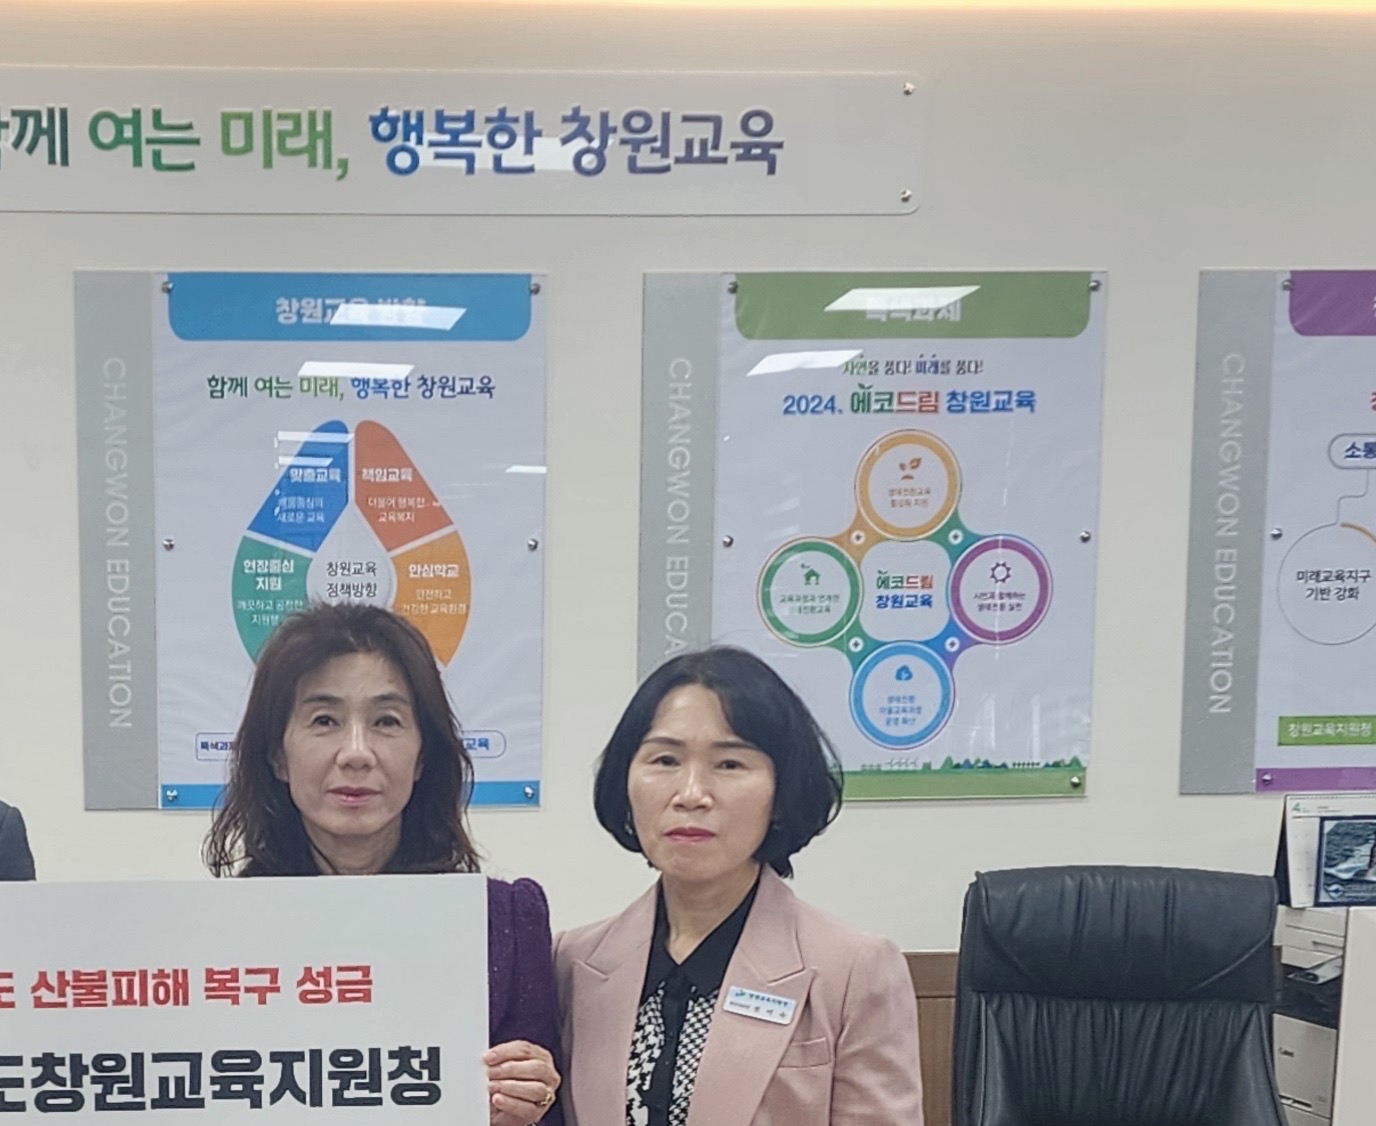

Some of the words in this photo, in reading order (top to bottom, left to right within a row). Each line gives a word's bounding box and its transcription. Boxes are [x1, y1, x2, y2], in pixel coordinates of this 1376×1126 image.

[88, 106, 202, 172] 여는
[220, 107, 349, 181] 미래,
[369, 105, 543, 176] 행복한
[559, 105, 784, 176] 창원교육
[276, 296, 370, 324] 창원교
[207, 375, 248, 399] 함께
[254, 376, 292, 399] 여는
[300, 375, 344, 401] 미래,
[351, 375, 410, 399] 행복한
[417, 375, 496, 399] 창원교육
[783, 395, 843, 414] 2024.
[850, 386, 940, 414] 에코드림
[946, 390, 1036, 414] 창원교육
[102, 357, 129, 547] CHANGWON
[667, 357, 692, 544] CHANGWON
[1215, 353, 1245, 537] CHANGWON
[326, 561, 376, 576] 창원교육
[876, 571, 934, 590] 에코드림
[1296, 569, 1372, 584] 미래교육지구
[326, 582, 377, 598] 정책방향
[876, 594, 933, 609] 창원교육
[1306, 587, 1330, 600] 기반
[1334, 587, 1360, 600] 강화
[664, 556, 689, 656] EDUCA
[106, 558, 133, 728] EDUCATION
[1209, 549, 1238, 714] EDUCATION
[31, 968, 191, 1010] 산불피해
[203, 966, 282, 1007] 복구
[295, 964, 375, 1004] 성금
